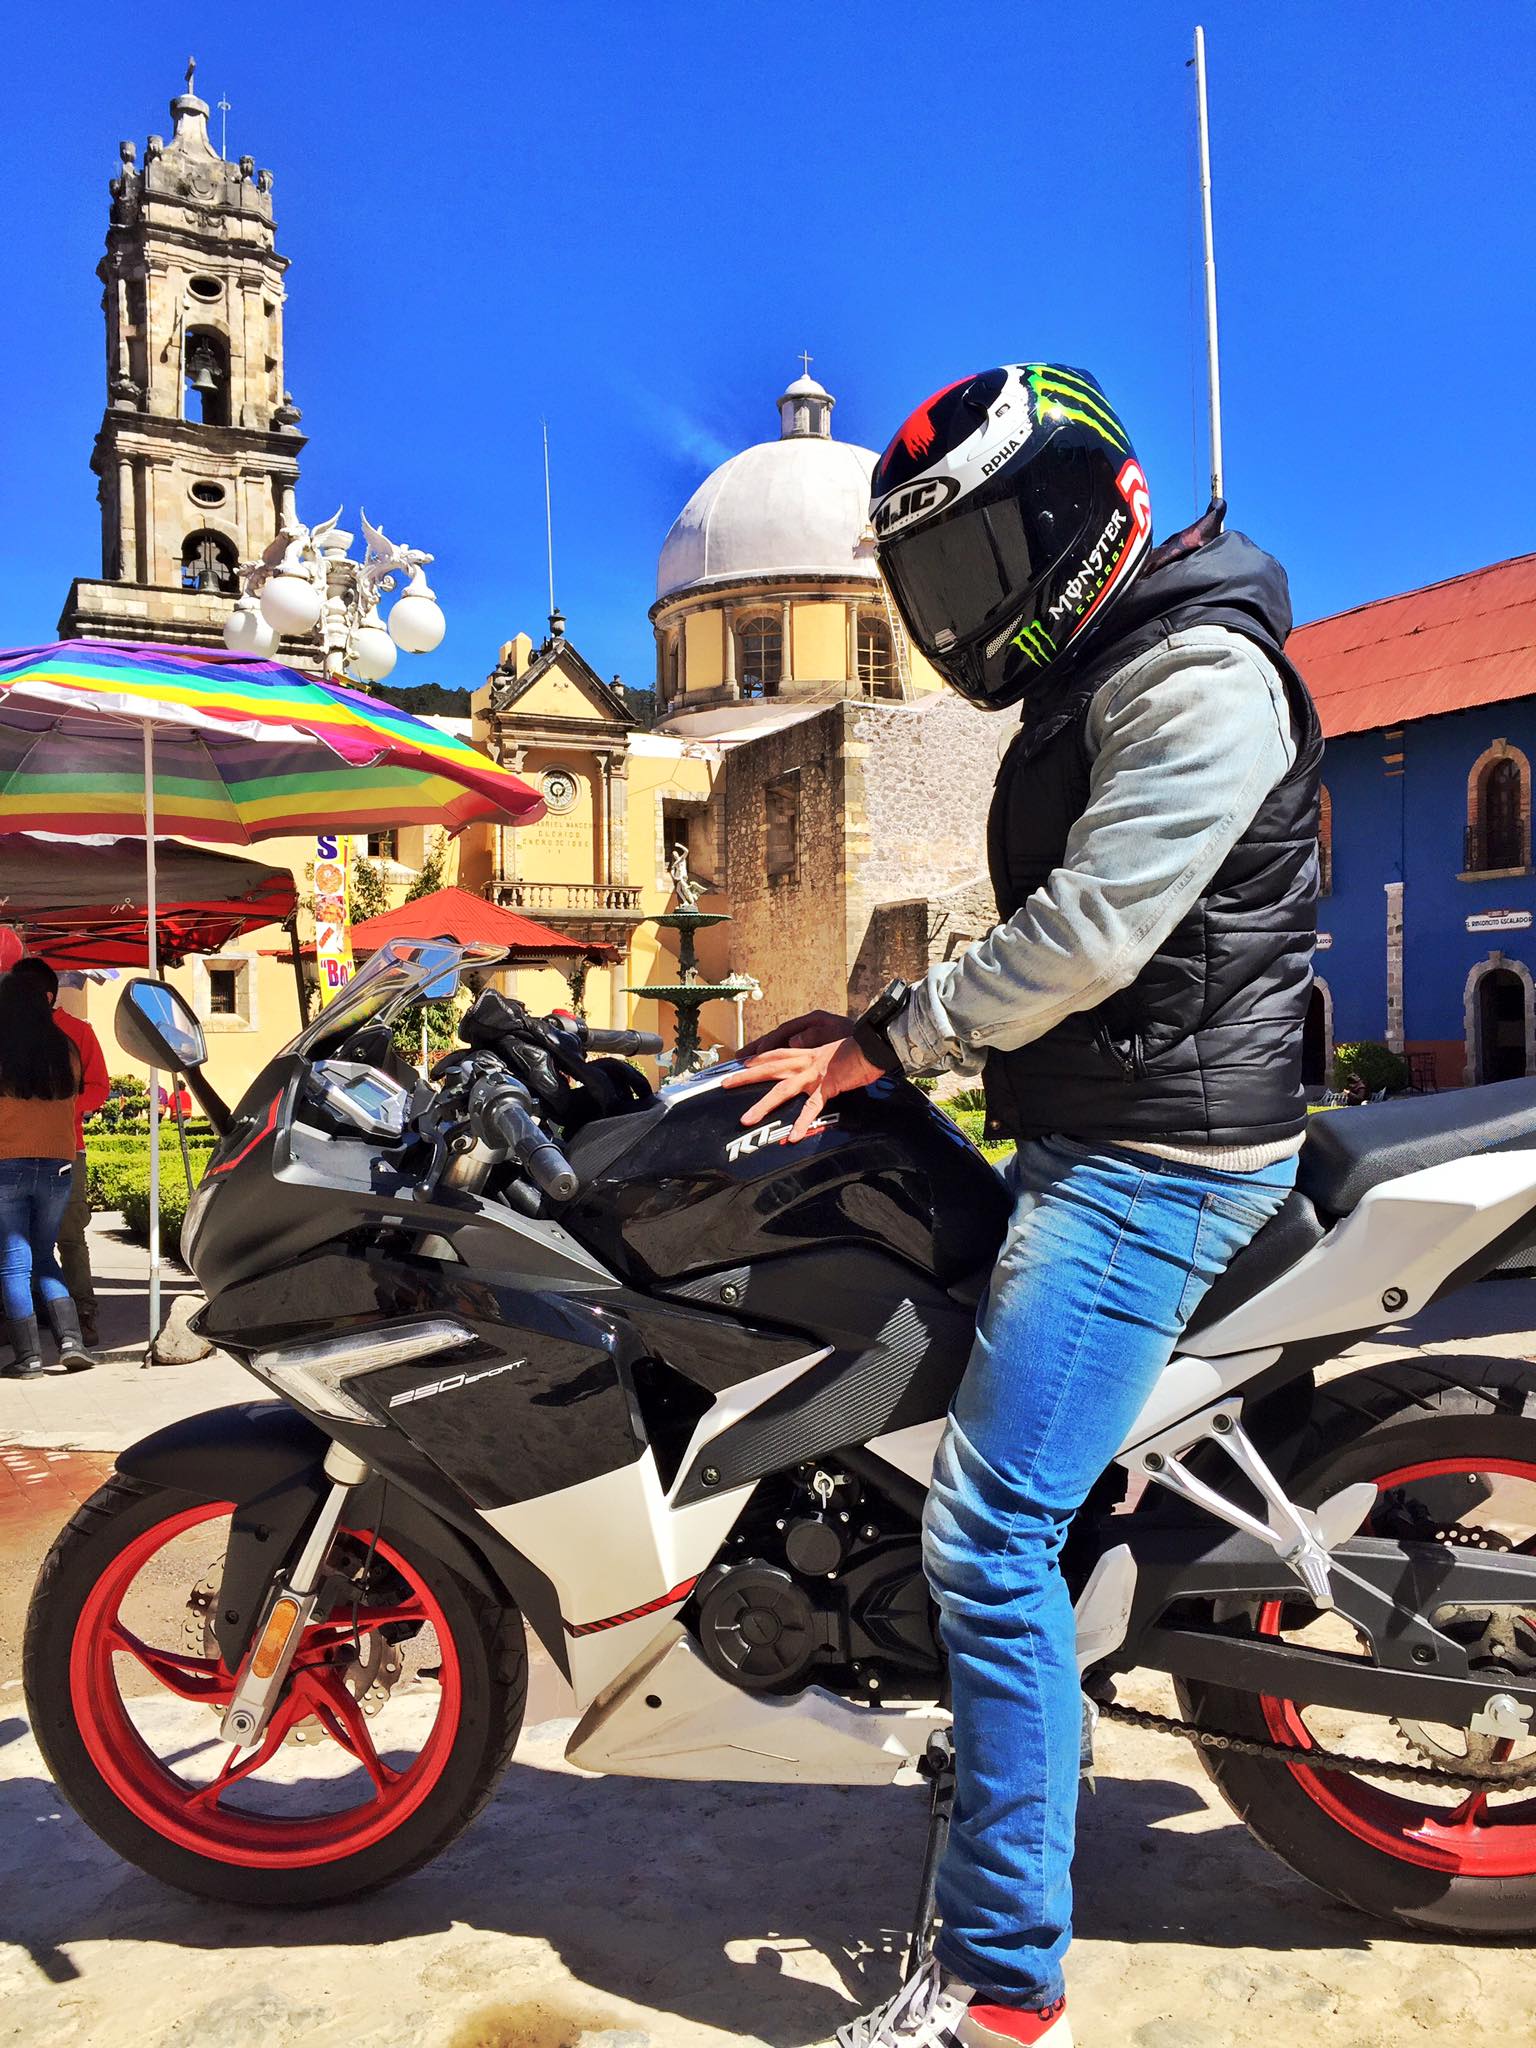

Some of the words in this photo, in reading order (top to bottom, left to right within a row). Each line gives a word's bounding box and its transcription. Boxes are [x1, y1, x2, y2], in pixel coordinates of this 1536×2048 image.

[981, 439, 1021, 477] RPHA
[875, 480, 938, 537] HJC
[1047, 508, 1127, 621] MONSTER
[1075, 538, 1125, 616] ENERGY
[389, 1371, 467, 1408] 250
[465, 1358, 527, 1385] SPORT
